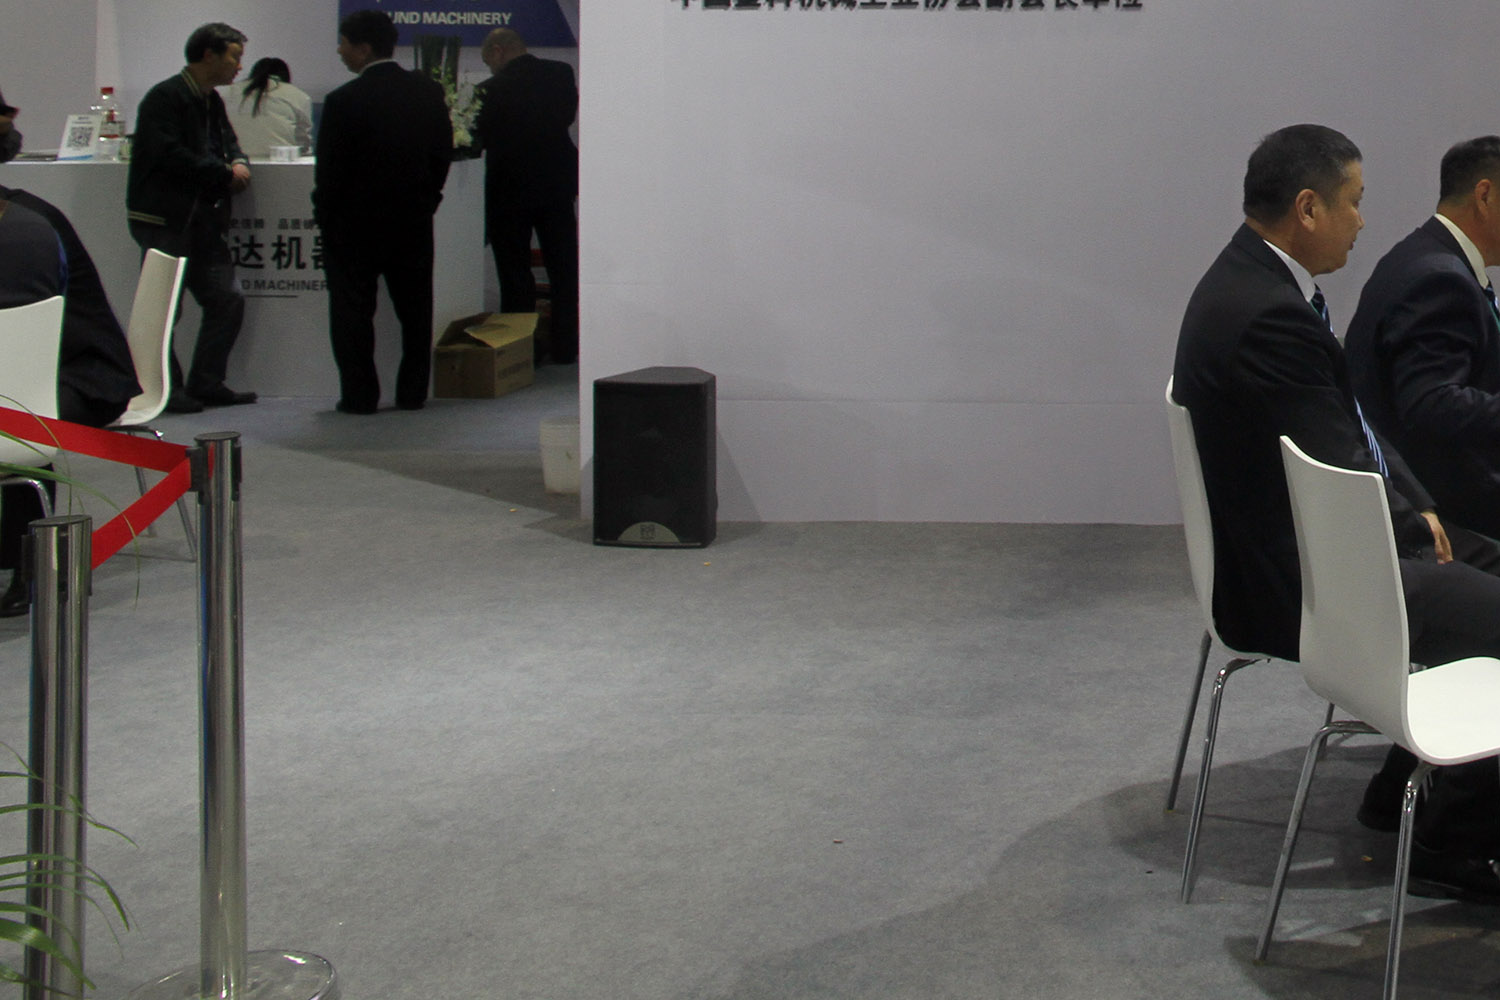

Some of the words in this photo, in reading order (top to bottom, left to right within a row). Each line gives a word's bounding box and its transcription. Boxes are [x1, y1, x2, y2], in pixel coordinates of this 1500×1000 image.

[388, 12, 420, 25] UND
[422, 12, 512, 25] MACHINERY
[230, 235, 325, 270] 达机
[254, 279, 328, 291] MACHINER
